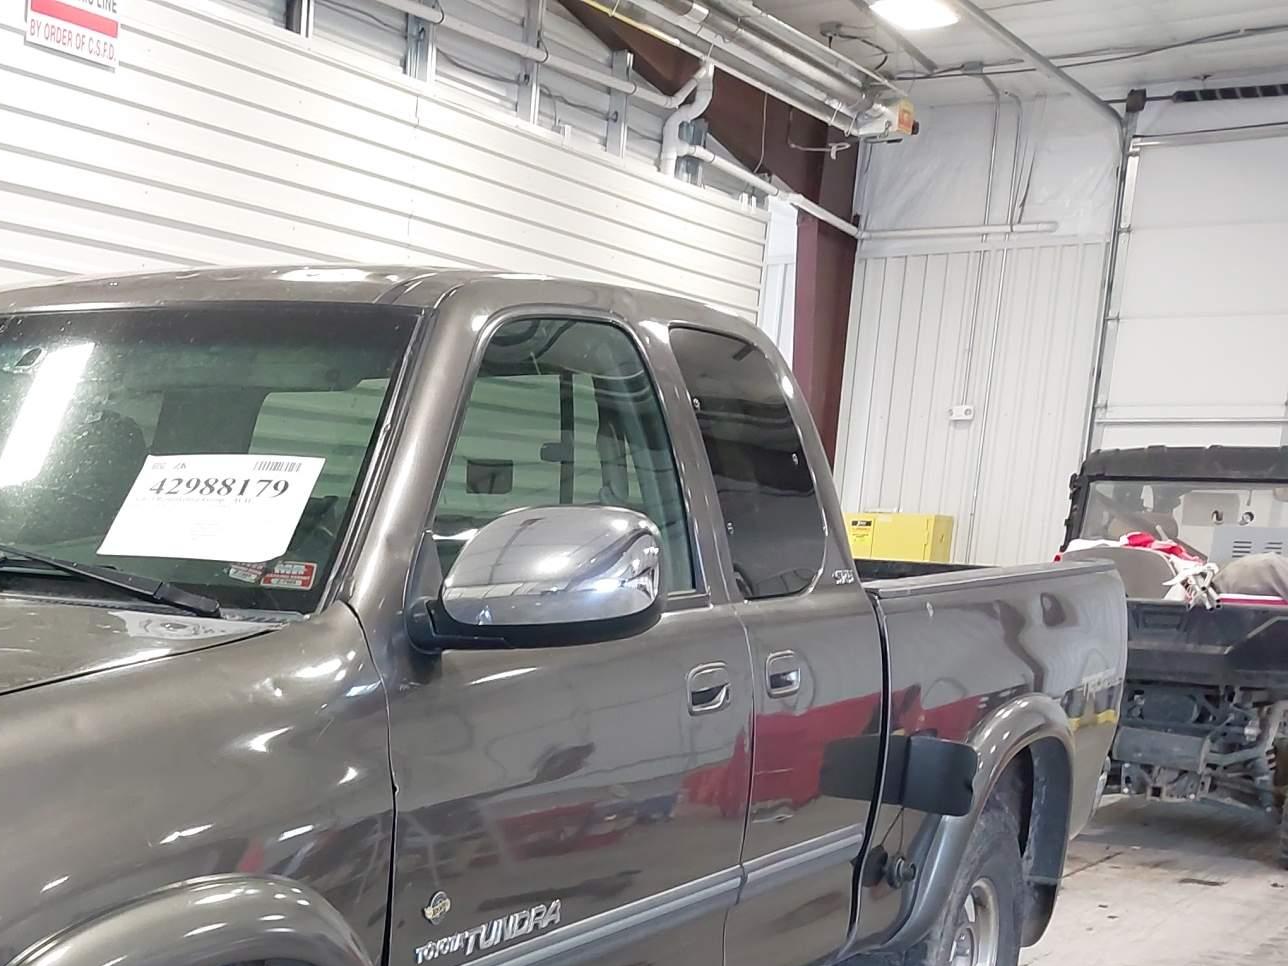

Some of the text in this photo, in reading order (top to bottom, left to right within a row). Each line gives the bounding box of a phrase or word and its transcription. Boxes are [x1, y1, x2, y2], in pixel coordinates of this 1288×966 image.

[30, 19, 41, 36] BY
[44, 23, 72, 48] ORDER
[75, 33, 85, 51] OF
[149, 477, 290, 498] 42988179
[464, 898, 562, 956] TUNDRA
